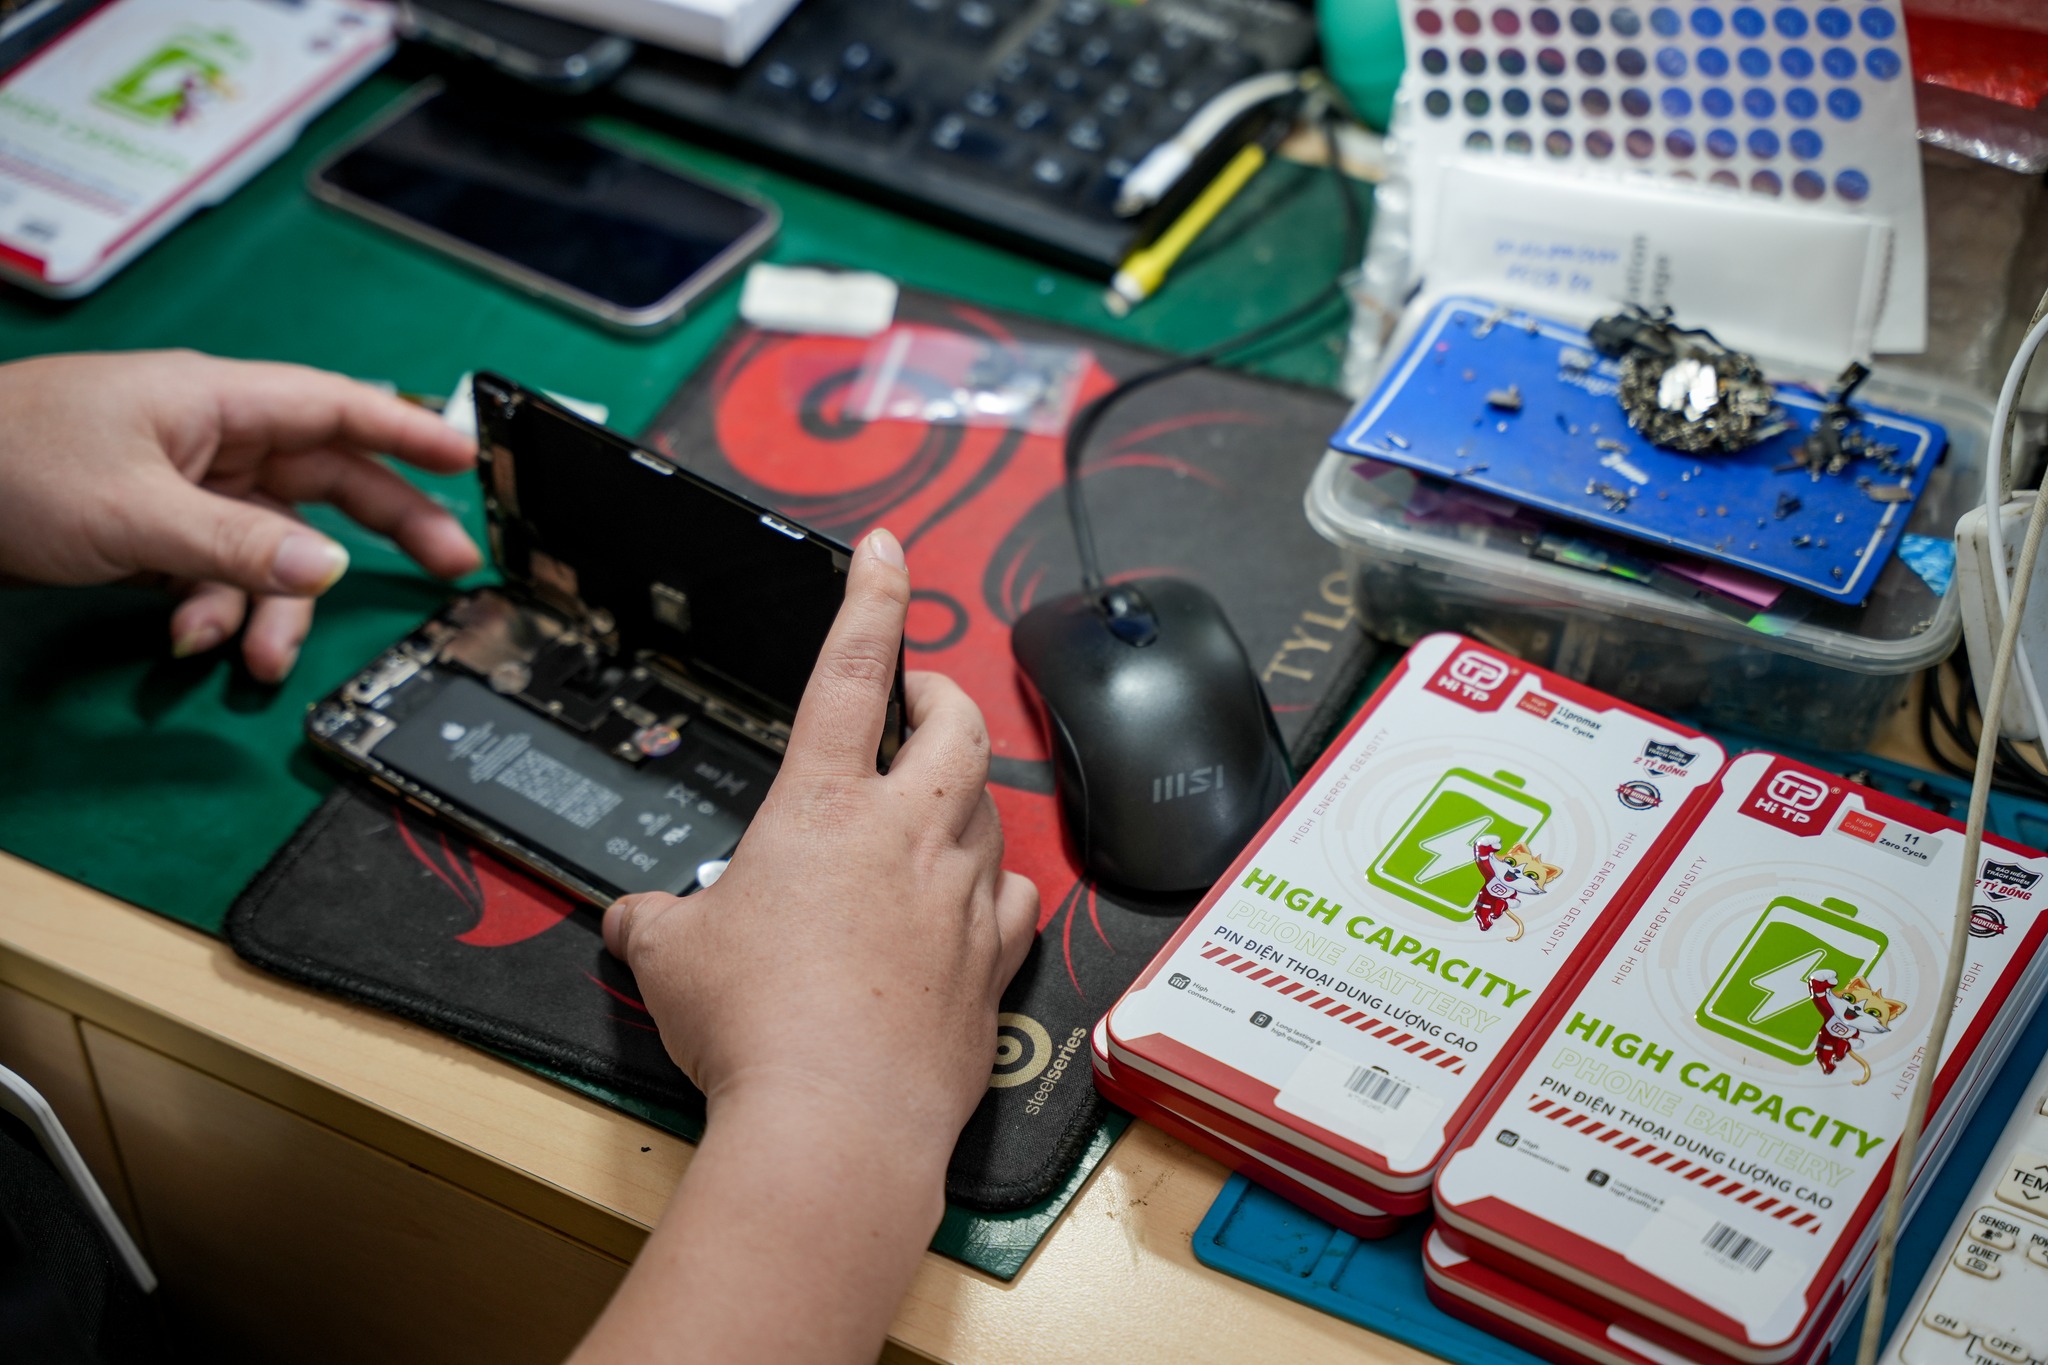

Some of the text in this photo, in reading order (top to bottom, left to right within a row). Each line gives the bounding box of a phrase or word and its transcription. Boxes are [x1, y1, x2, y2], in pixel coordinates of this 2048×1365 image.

[1550, 717, 1595, 740] Zero Cycle
[1153, 765, 1224, 803] MSI
[1289, 727, 1390, 845] HIGH ENERGY DENSITY
[1631, 791, 1655, 805] MONTHS
[1781, 808, 1812, 825] TP
[1855, 816, 1875, 830] High
[1844, 821, 1876, 839] Capacity
[1903, 833, 1921, 846] 11
[1878, 837, 1929, 861] Zero Cycle
[1541, 832, 1637, 955] HIGH ENERGY DENSITY
[1611, 856, 1707, 986] HIGH ENERGY DENSITY
[1971, 916, 2000, 931] MONTHS
[1240, 867, 1532, 1009] HIGH CAPACITY
[1226, 899, 1502, 1035] PHONE BATTERY
[1957, 962, 1984, 992] HIGH
[1192, 982, 1209, 994] High
[1213, 925, 1478, 1054] PIN ĐIỆN THOẠI DUNG LƯỢNG CAO
[1187, 988, 1236, 1015] conversion rate
[1271, 1027, 1311, 1050] high quality
[1275, 1021, 1293, 1034] Long
[1293, 1029, 1317, 1044] lasting
[1025, 1027, 1087, 1115] steelseries
[1891, 1046, 1927, 1100] DENSITY
[1565, 1011, 1885, 1160] HIGH CAPACITY
[1551, 1047, 1855, 1189] PHONE BATTERY
[1540, 1076, 1834, 1211] PIN ĐIỆN THOẠI DUNG LƯỢNG CAO
[1978, 1214, 2021, 1236] SENSOR
[1967, 1244, 2002, 1263] QUIET
[1934, 1314, 1959, 1330] ON
[1990, 1337, 2022, 1355] OFF
